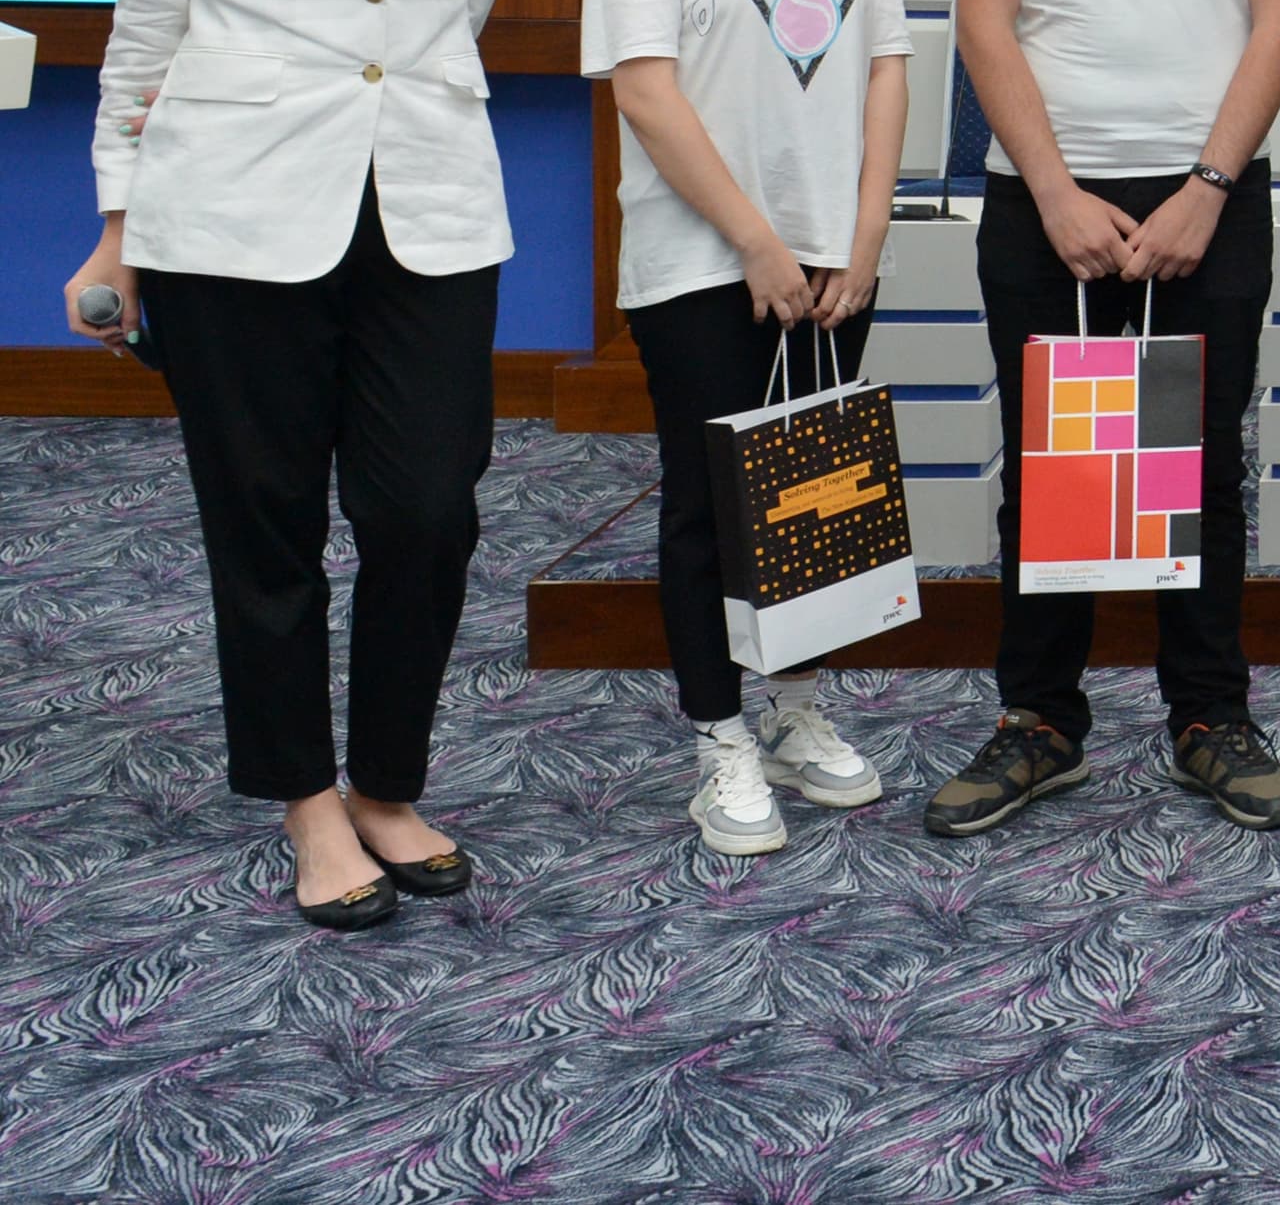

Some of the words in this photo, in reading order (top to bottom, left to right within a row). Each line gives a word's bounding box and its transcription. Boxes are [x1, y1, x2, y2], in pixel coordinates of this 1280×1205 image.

[784, 483, 820, 501] Solving
[823, 467, 865, 488] Together
[1156, 573, 1179, 584] pwc
[882, 609, 903, 624] pwc
